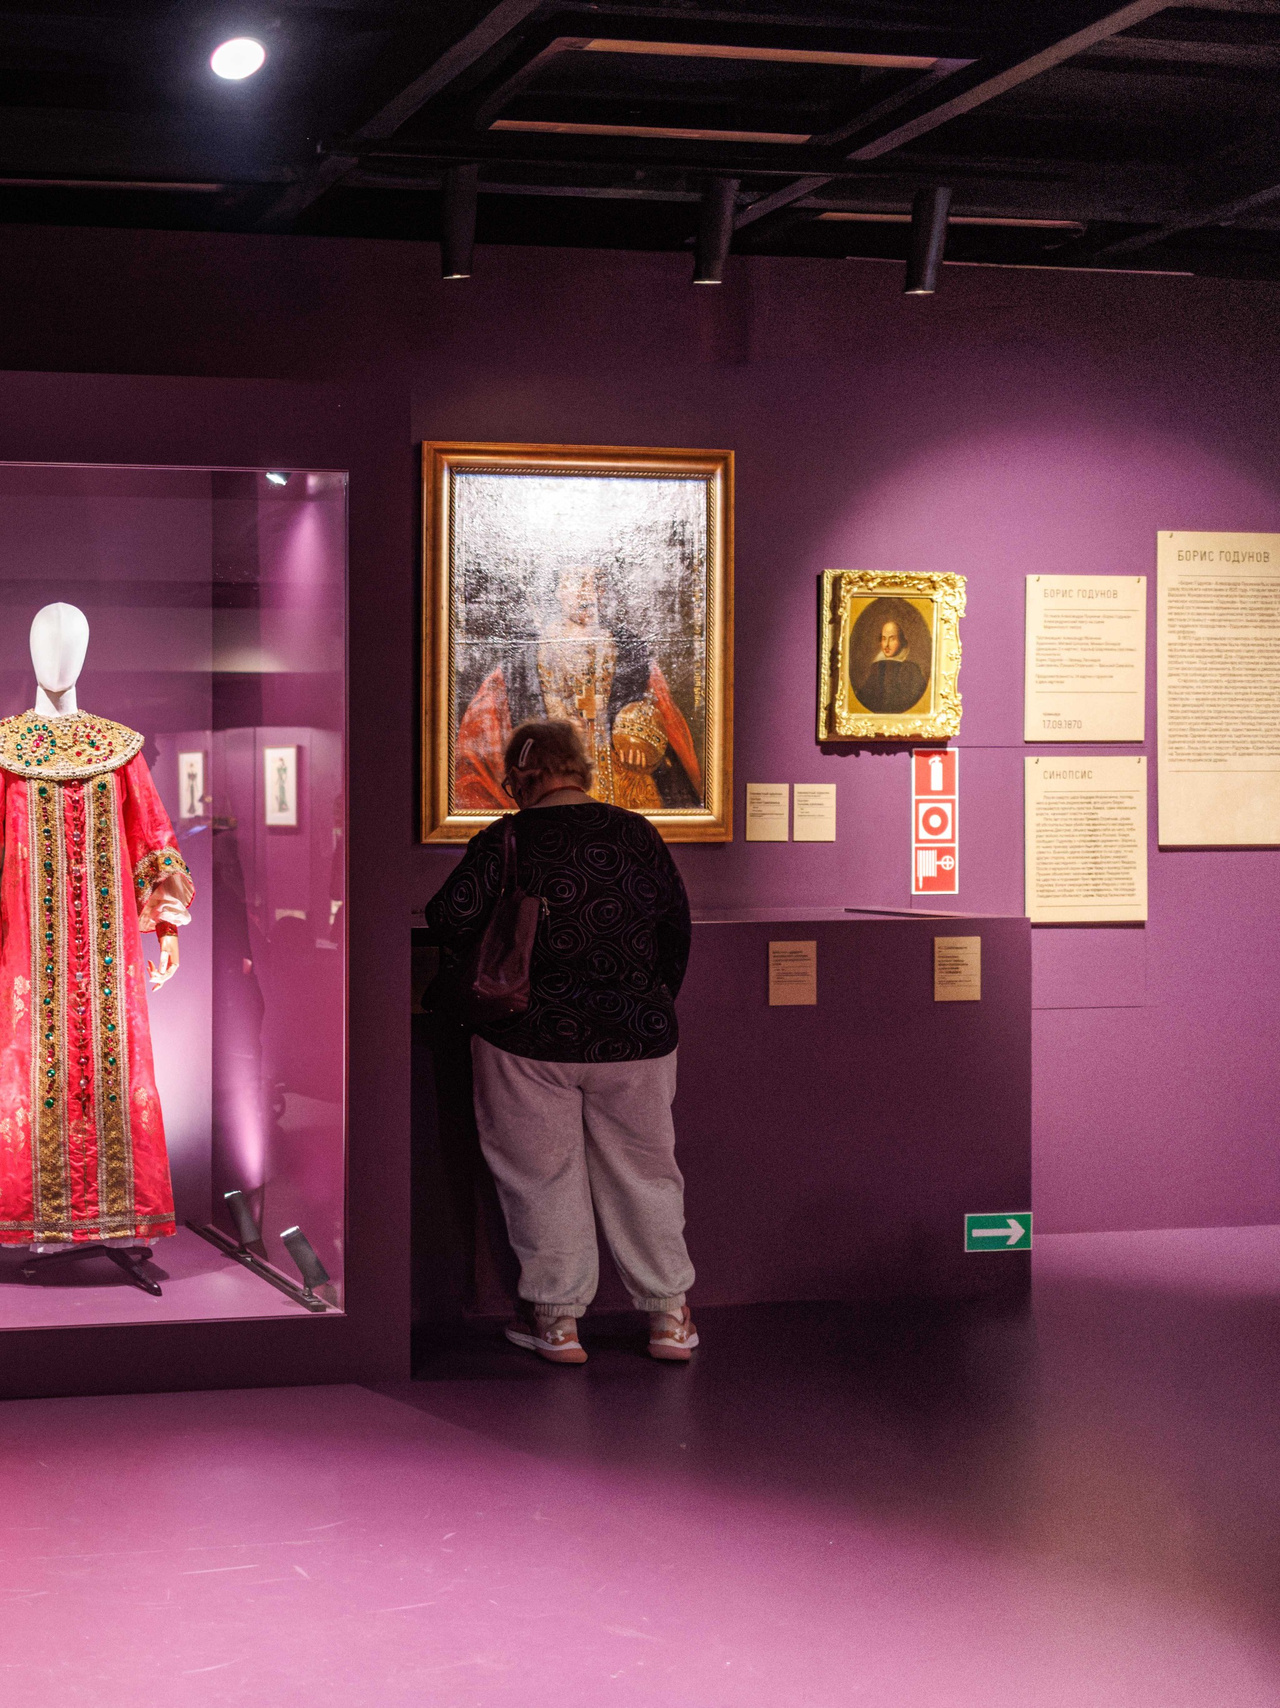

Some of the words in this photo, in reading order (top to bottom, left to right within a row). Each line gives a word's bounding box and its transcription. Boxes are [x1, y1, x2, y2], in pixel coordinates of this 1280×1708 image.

[1177, 549, 1215, 562] БОРИС
[1219, 550, 1271, 564] ГОДУНОВ
[1043, 588, 1074, 598] БОРИС
[1077, 588, 1119, 599] ГОДУНОВ
[1042, 719, 1083, 729] 17.09.1870
[1043, 770, 1093, 780] СИНОПСИС
